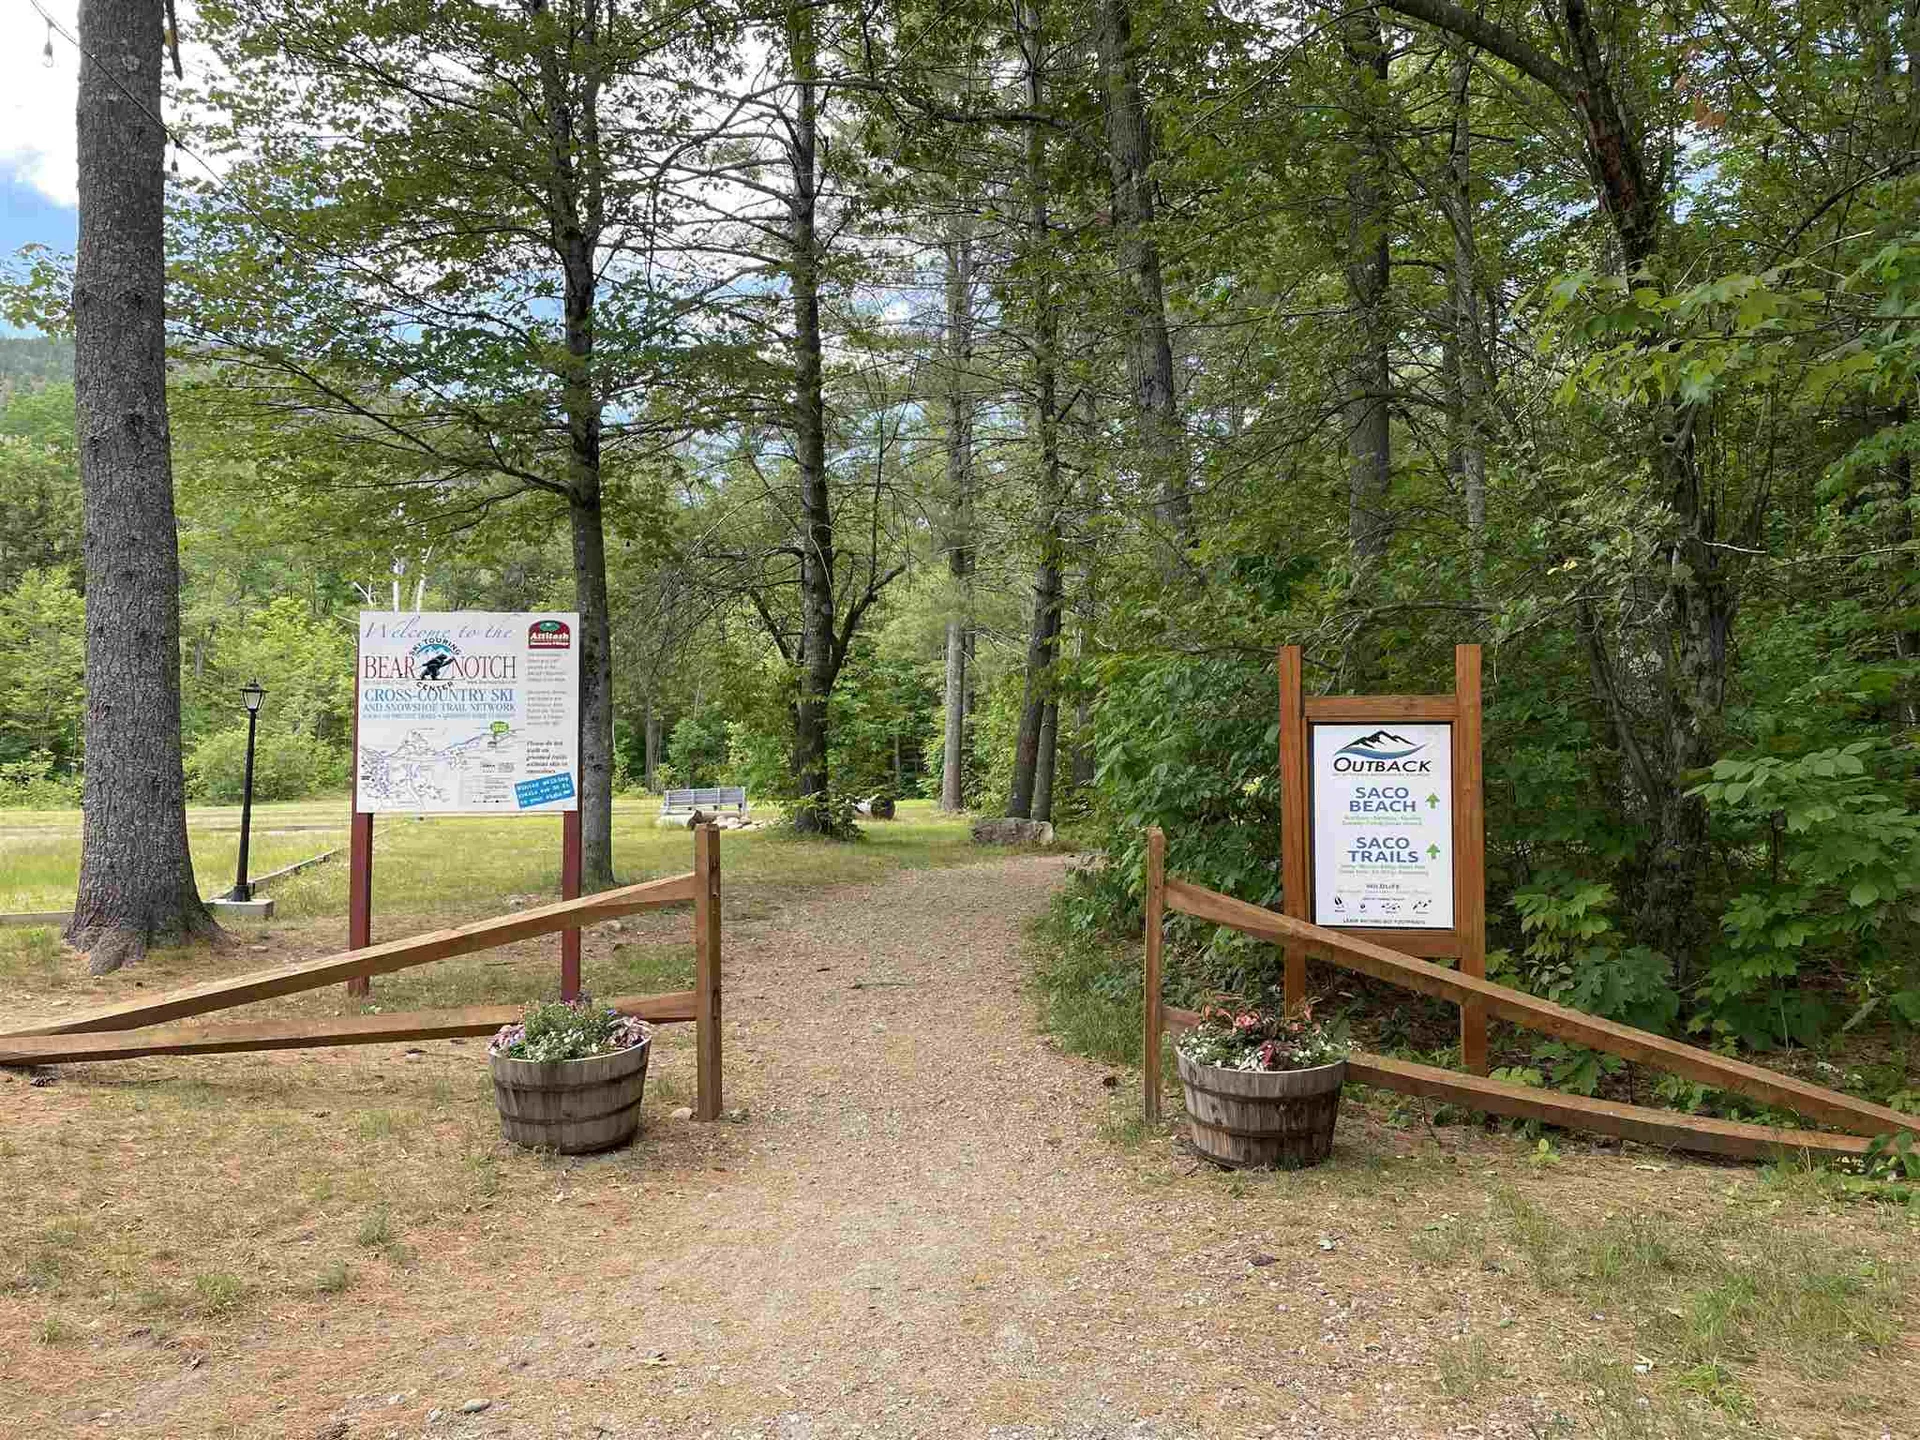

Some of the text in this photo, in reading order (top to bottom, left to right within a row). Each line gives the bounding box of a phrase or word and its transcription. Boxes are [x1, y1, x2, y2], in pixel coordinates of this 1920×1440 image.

[365, 616, 513, 638] Welcome to the
[530, 632, 569, 640] Attitash
[410, 637, 461, 657] SKI TOURING
[364, 656, 415, 679] BEAR
[452, 656, 517, 679] NOTCH
[416, 681, 454, 692] CENTER
[364, 688, 513, 702] CROSS-COUNTRY SKI
[363, 703, 517, 712] AND SNOWSHOE TRAIL NETWORK
[1333, 757, 1432, 772] OUTBACK
[1355, 787, 1409, 799] SACO
[1349, 801, 1416, 812] BEACH
[1356, 837, 1410, 849] SACO
[1347, 850, 1419, 863] TRAILS
